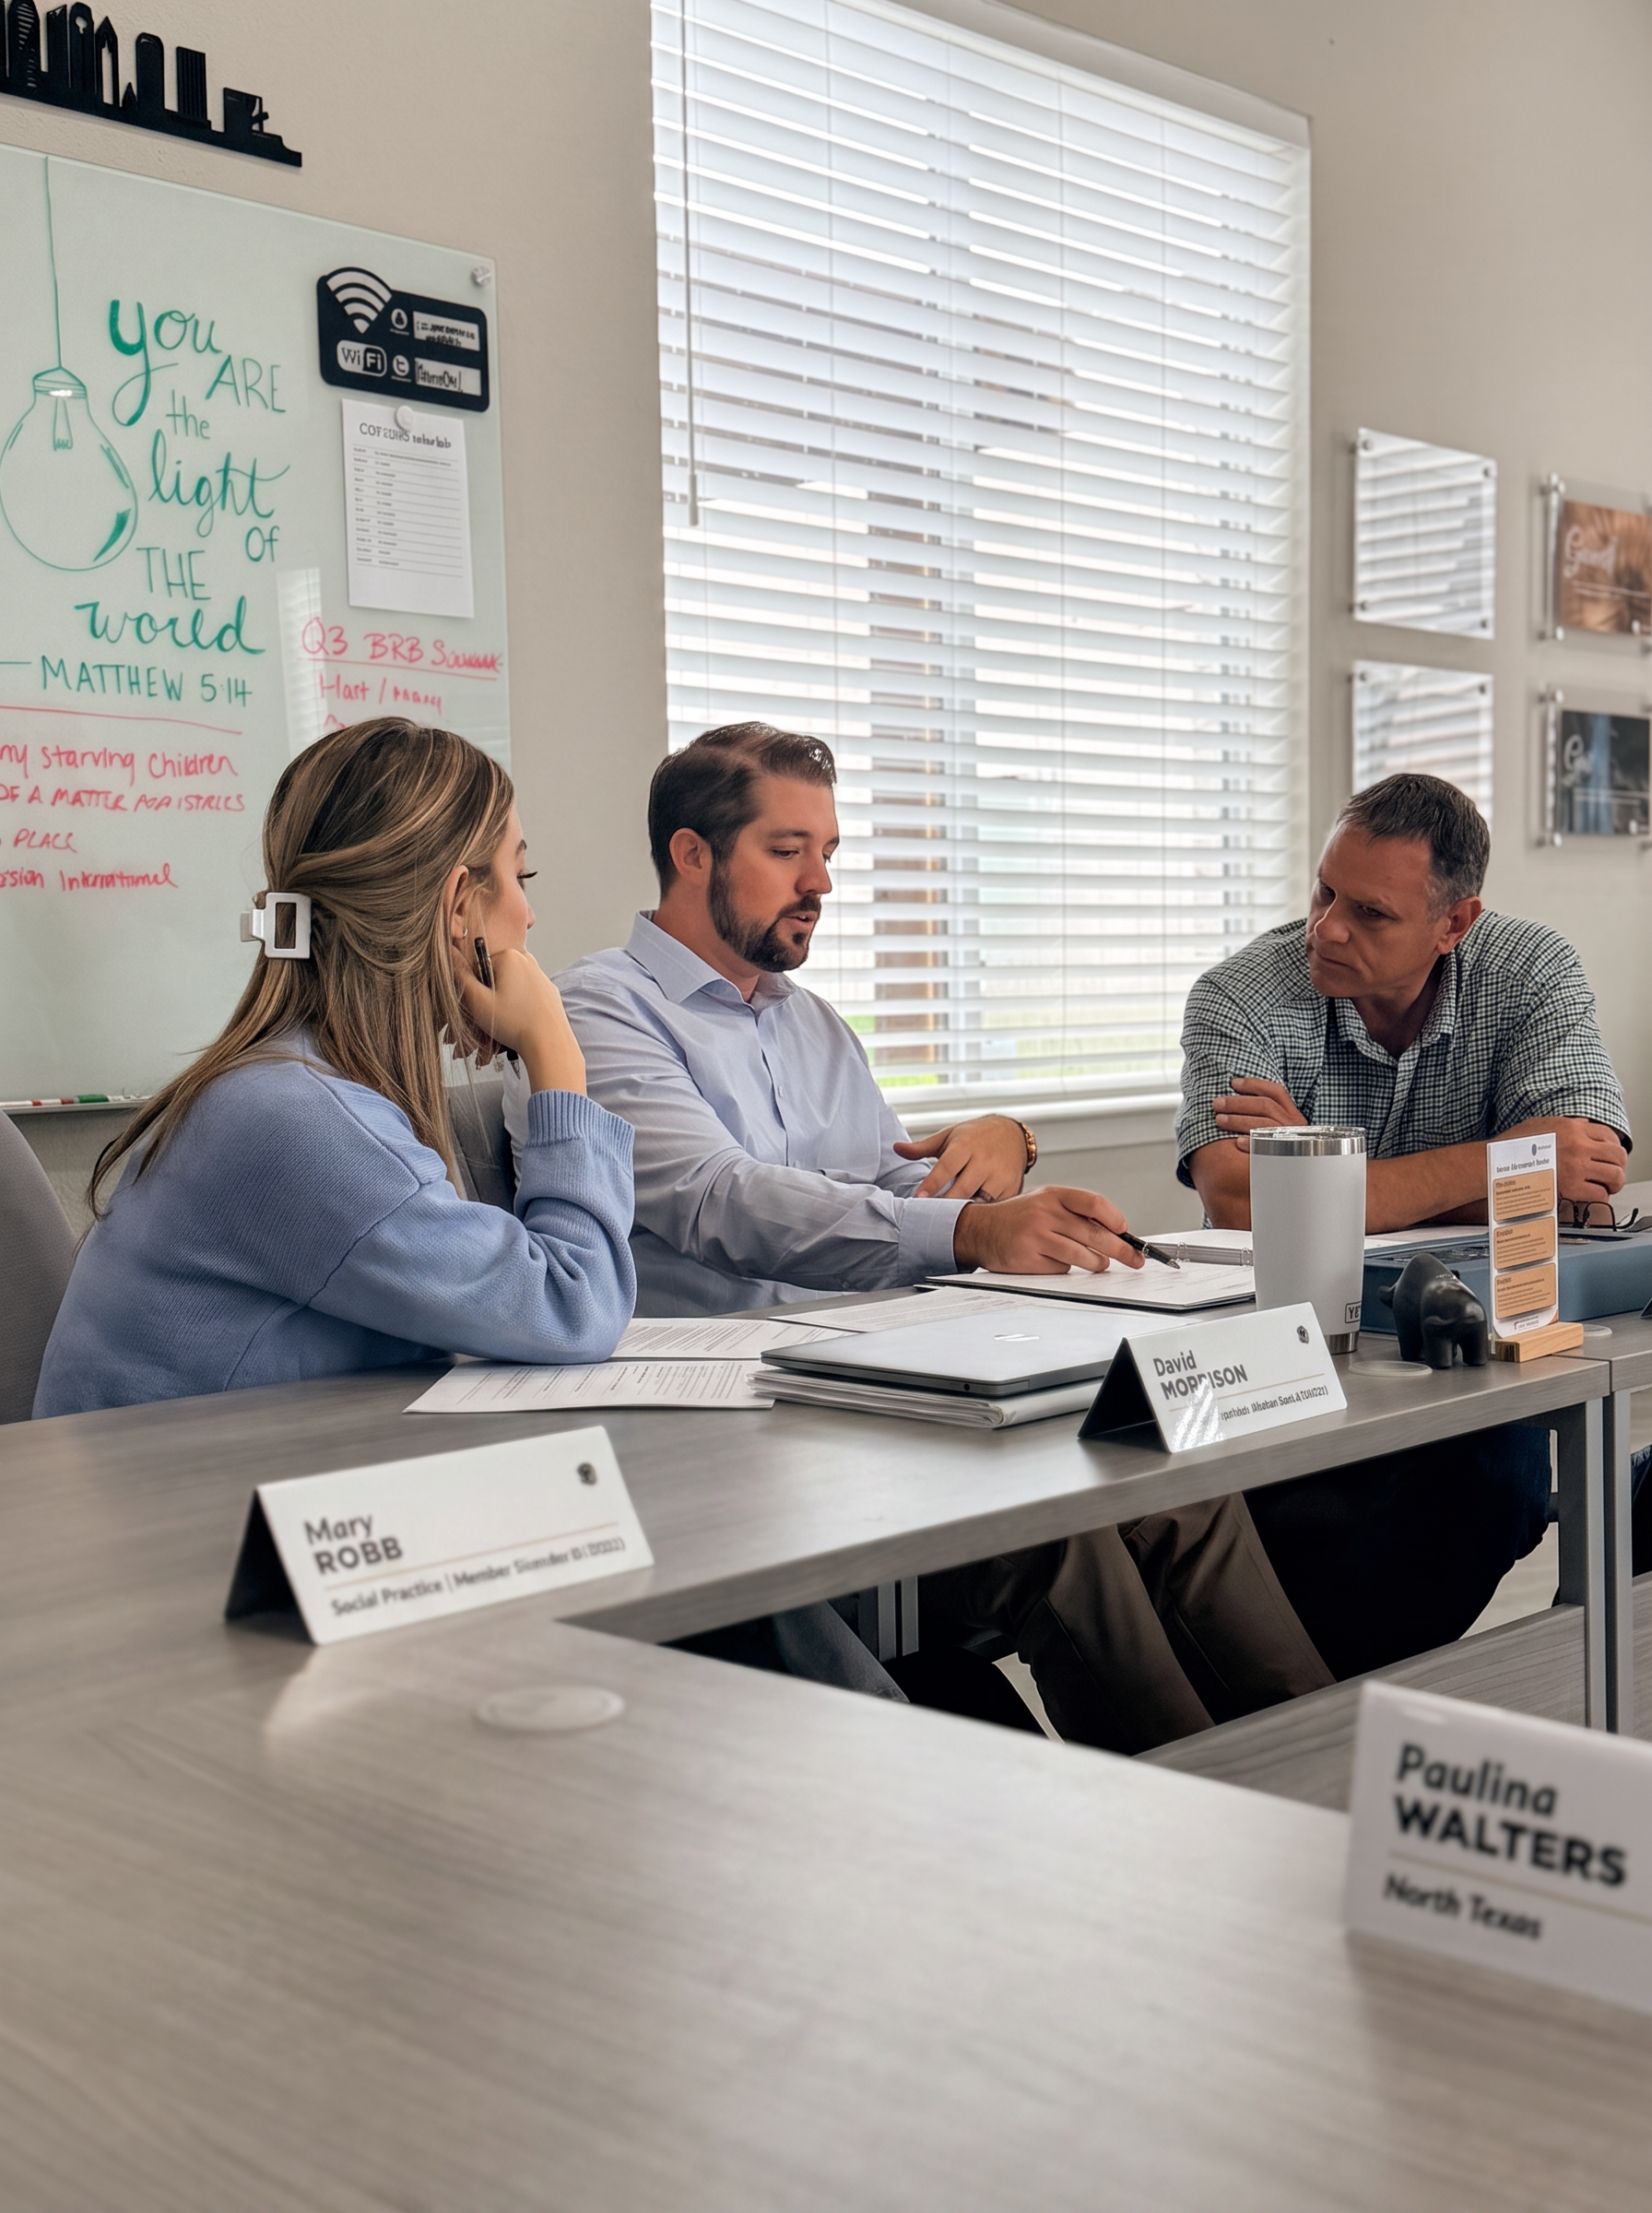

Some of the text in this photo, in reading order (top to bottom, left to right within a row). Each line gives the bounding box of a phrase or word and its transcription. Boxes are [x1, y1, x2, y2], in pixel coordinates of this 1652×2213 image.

[109, 300, 222, 426] you
[206, 354, 286, 412] ARE
[166, 389, 210, 439] the
[148, 429, 289, 538] light
[136, 547, 211, 600] THE
[75, 596, 266, 655] world
[301, 616, 348, 656] Q3
[364, 633, 423, 664] BRB
[41, 655, 183, 702] MATTHEW
[1349, 1306, 1361, 1320] YE
[1153, 1350, 1197, 1377] David
[304, 1515, 372, 1545] Mary
[314, 1536, 404, 1575] ROBB
[332, 1592, 380, 1616] Social
[382, 1578, 443, 1604] Practice
[454, 1565, 512, 1587] Member
[1396, 1743, 1557, 1817] Paulina
[1395, 1794, 1627, 1887] WALTERS
[1384, 1873, 1542, 1939] North Texas
